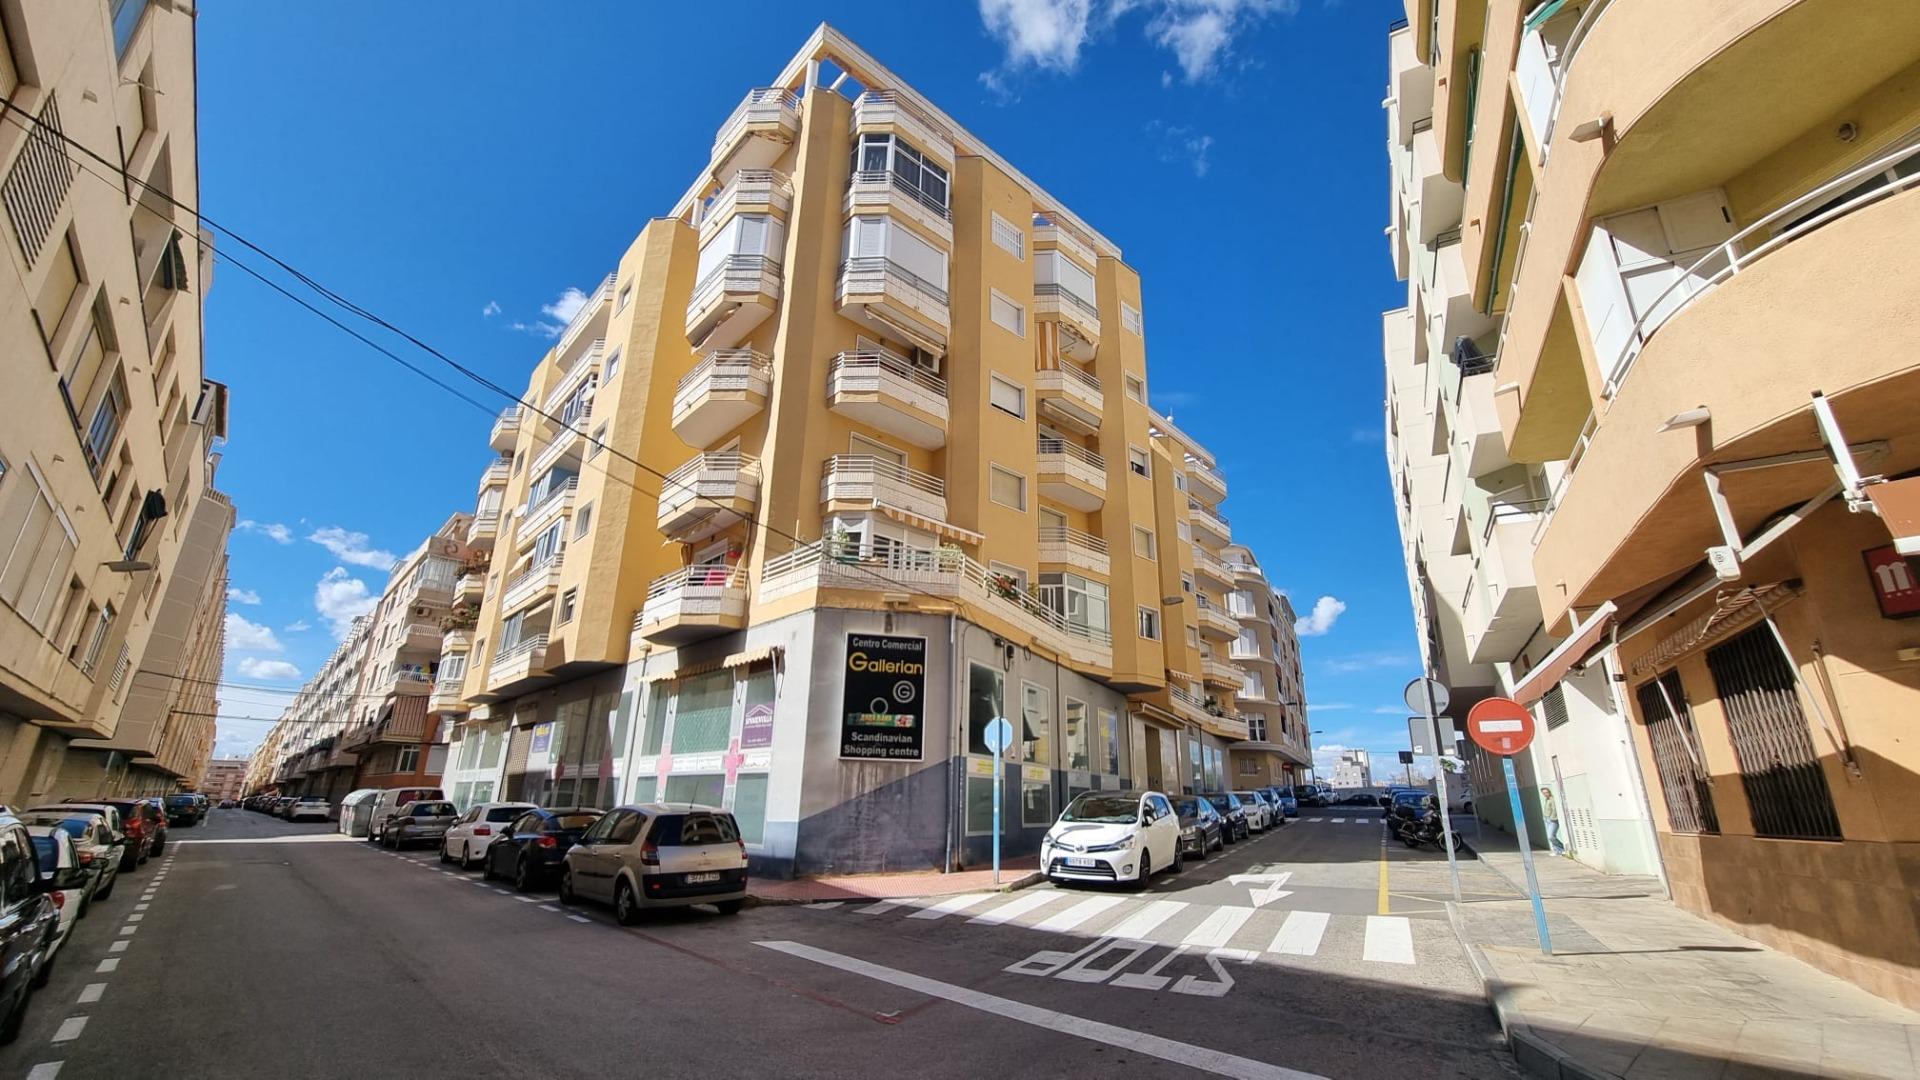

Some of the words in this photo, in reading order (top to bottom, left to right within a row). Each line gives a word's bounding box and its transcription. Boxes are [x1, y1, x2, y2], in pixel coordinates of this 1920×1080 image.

[853, 637, 880, 648] Centro
[882, 640, 922, 651] Comercial
[849, 652, 923, 675] Gallerian
[851, 732, 912, 743] Scandinavian
[844, 745, 887, 757] Shopping
[889, 747, 919, 756] centre
[1002, 936, 1260, 997] STOP
